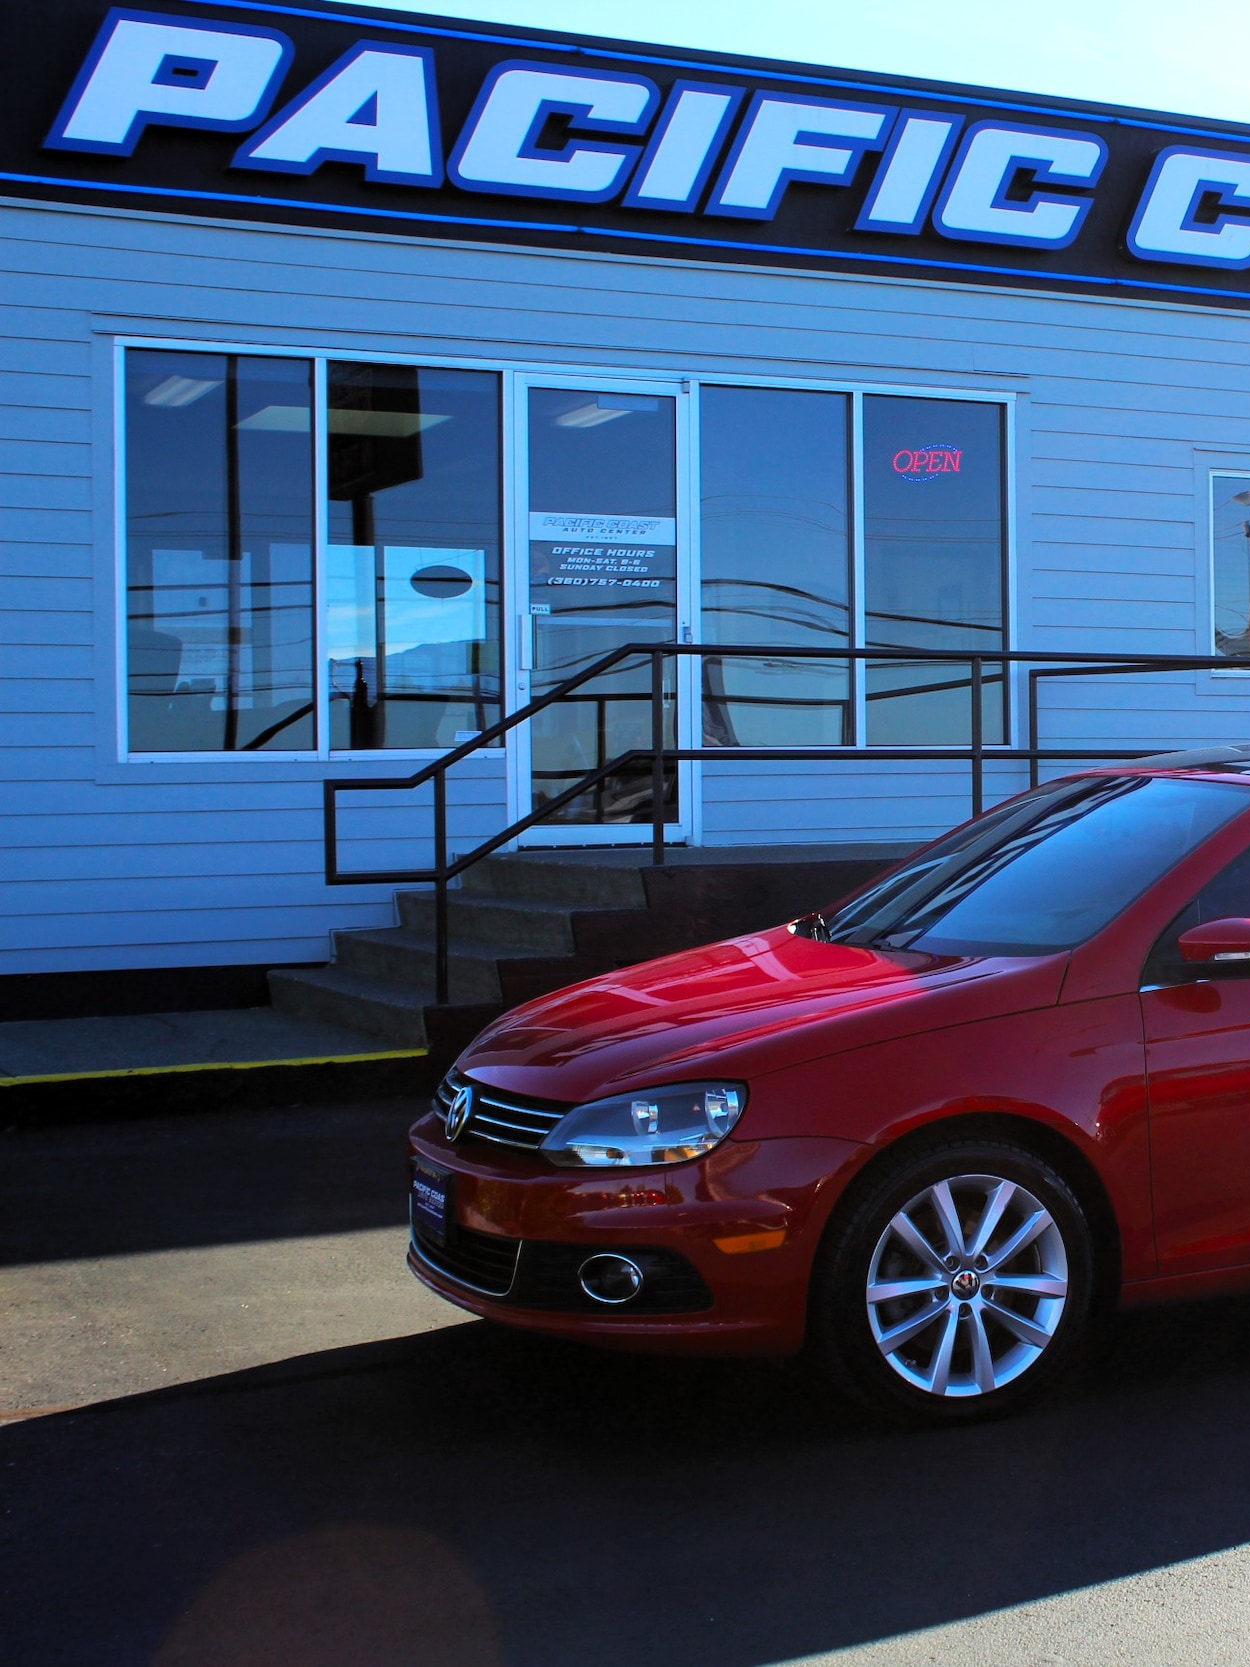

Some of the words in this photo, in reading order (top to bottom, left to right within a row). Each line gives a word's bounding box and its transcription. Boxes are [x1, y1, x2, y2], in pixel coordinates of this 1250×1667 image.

[43, 7, 1108, 249] PACIFIC
[892, 449, 963, 473] OPEN
[543, 516, 603, 529] PACIFIC
[607, 519, 661, 531] COAST
[552, 546, 604, 556] OFFICE
[606, 548, 656, 558] HOURS
[559, 563, 603, 571] SUNDAY
[605, 565, 649, 573] CLOSED
